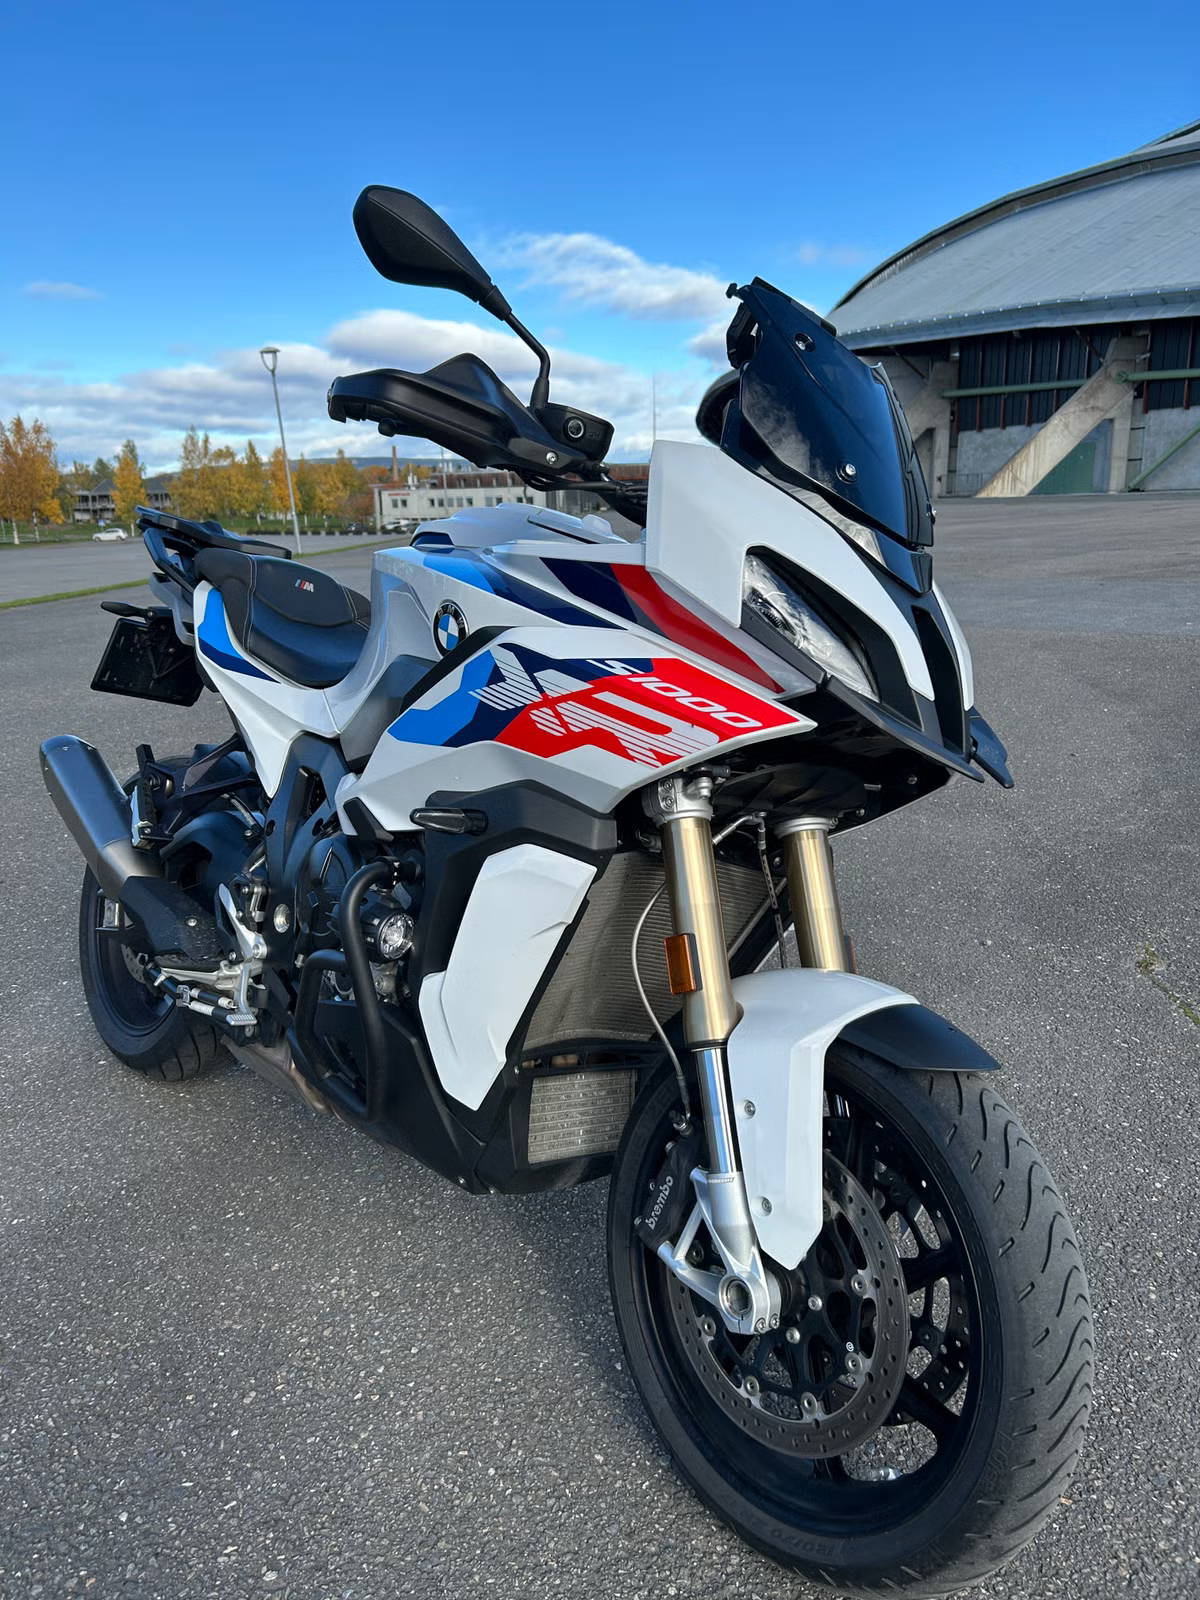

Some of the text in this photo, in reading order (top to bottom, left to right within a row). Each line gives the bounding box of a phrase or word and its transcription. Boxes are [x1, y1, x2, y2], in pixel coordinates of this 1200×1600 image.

[438, 604, 465, 628] BMW
[626, 677, 763, 728] 1000
[645, 1175, 674, 1230] brembo
